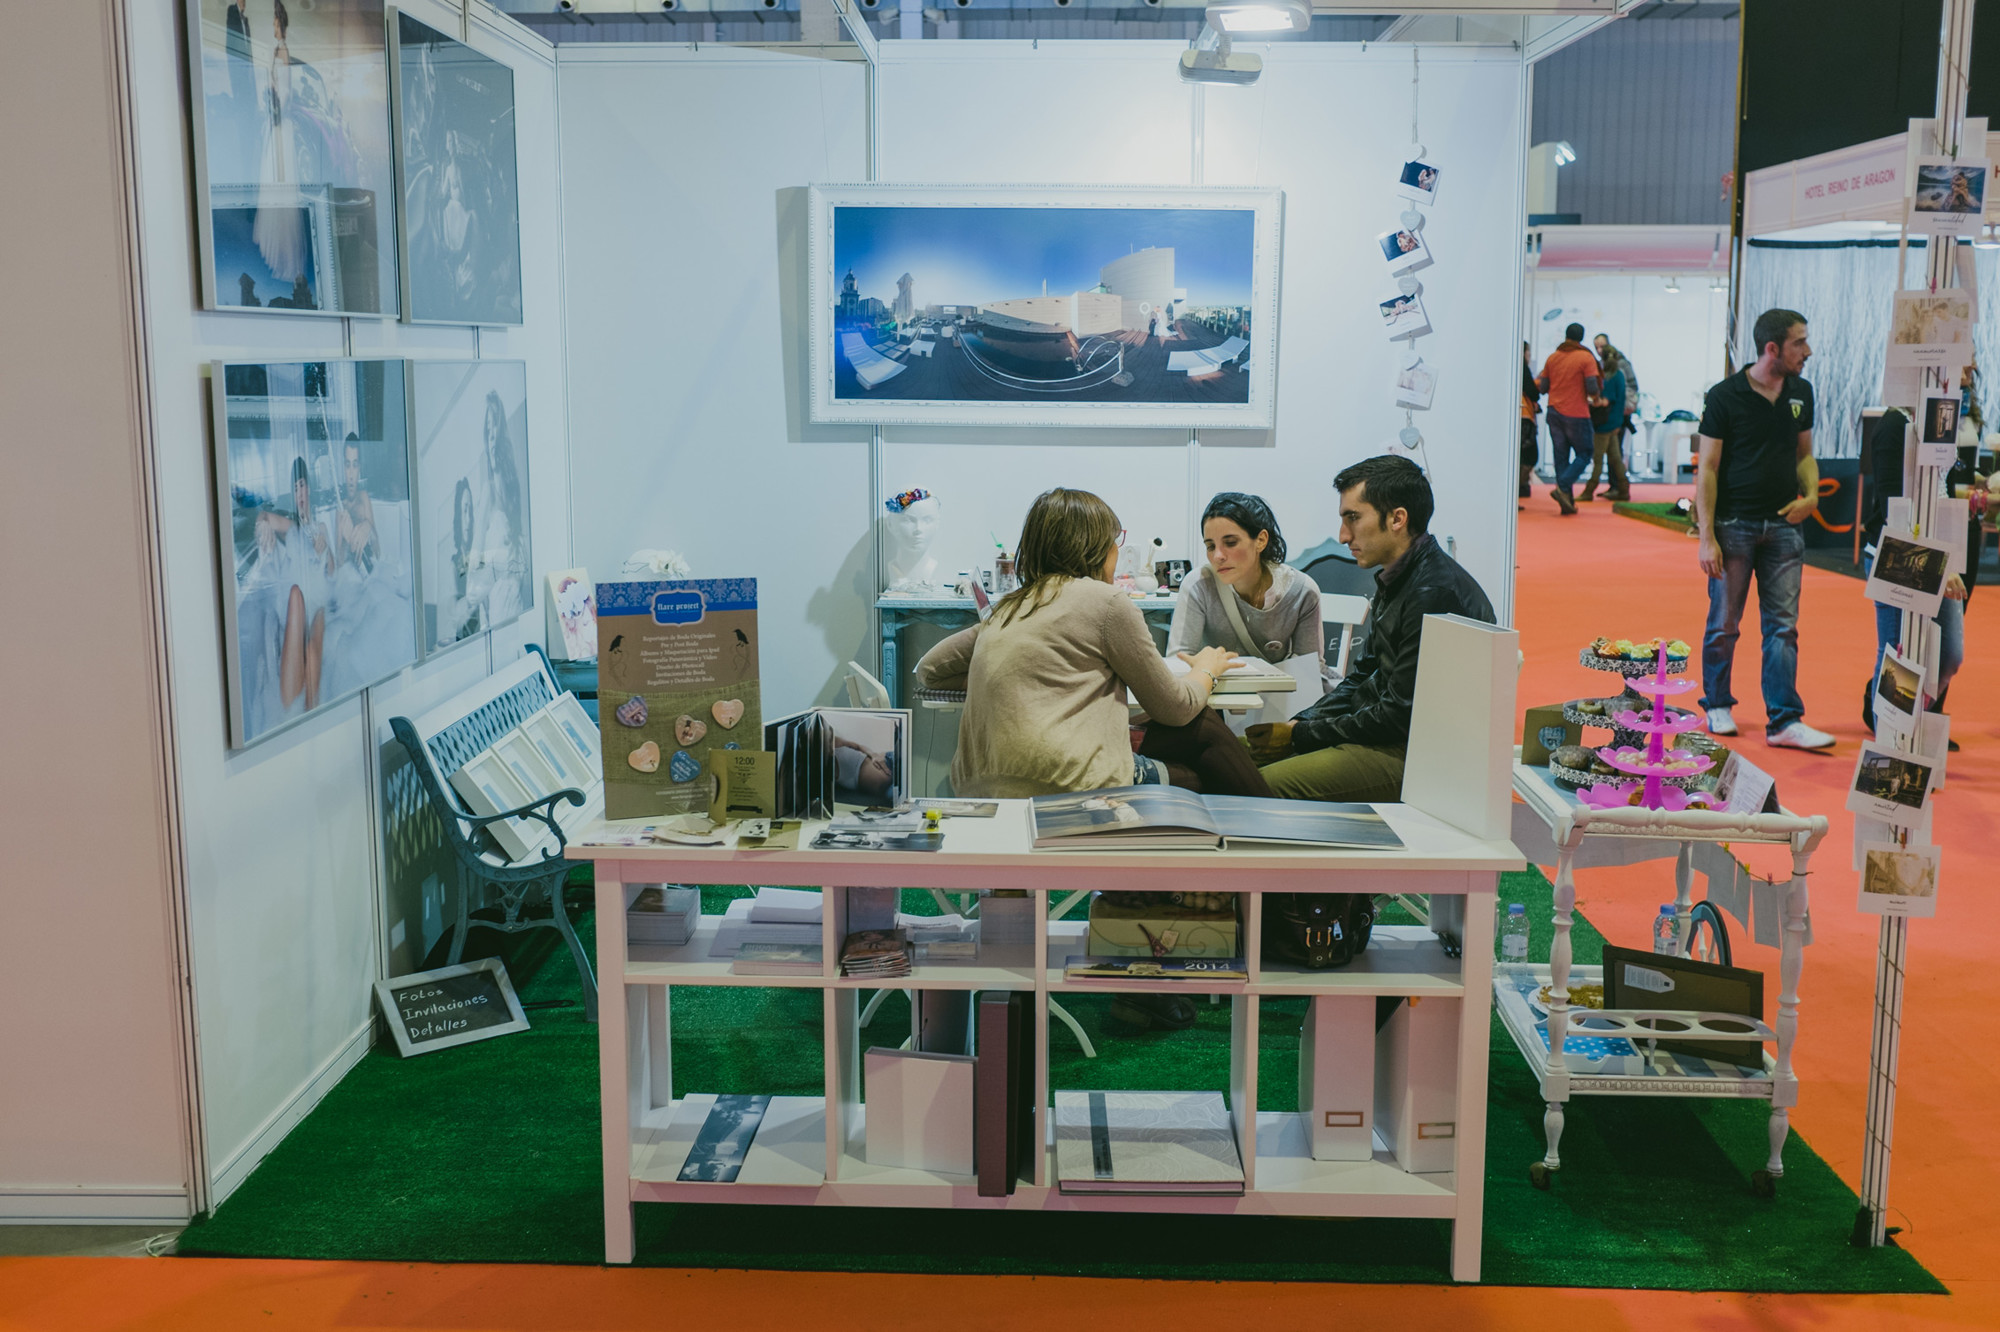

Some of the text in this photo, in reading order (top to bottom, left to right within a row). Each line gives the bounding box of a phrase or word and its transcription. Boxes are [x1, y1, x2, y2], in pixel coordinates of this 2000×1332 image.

[1804, 167, 1896, 199] HOTEL REINO DE ARAGON
[675, 602, 699, 611] project
[734, 756, 755, 765] 12:00
[1184, 962, 1231, 970] 2014
[398, 988, 444, 1003] Fotos
[403, 994, 488, 1021] Invitaciones
[410, 1017, 468, 1039] Detalles
